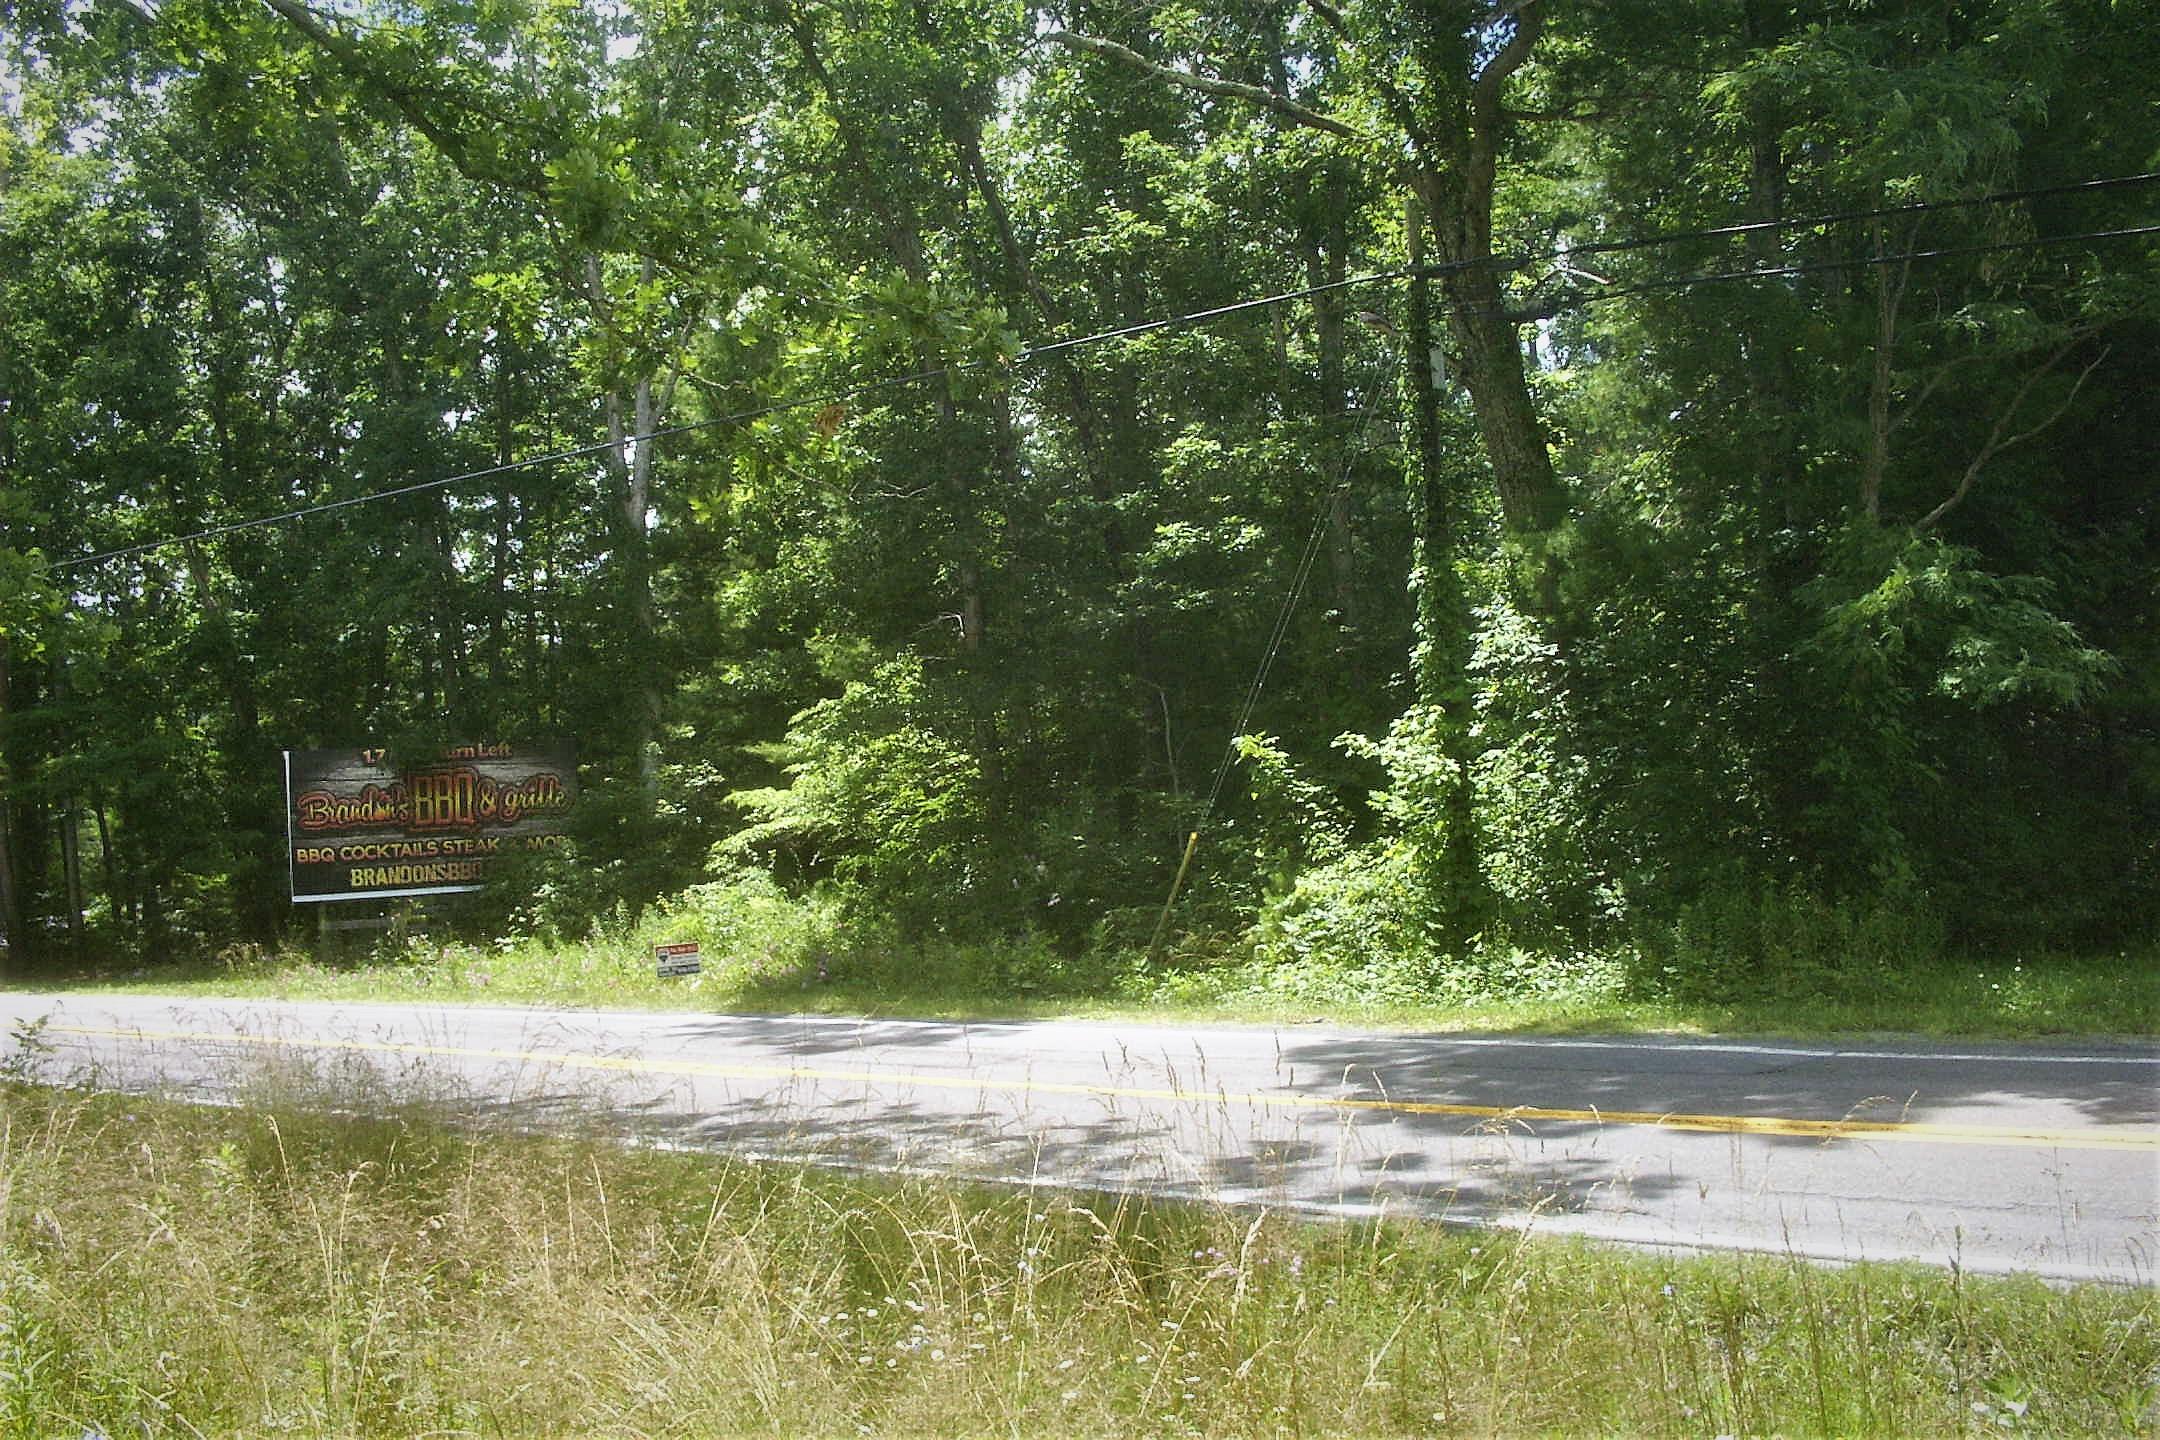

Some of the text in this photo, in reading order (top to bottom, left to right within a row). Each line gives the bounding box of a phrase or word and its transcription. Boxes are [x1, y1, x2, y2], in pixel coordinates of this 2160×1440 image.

[415, 773, 476, 825] BBQ
[479, 779, 497, 817] &
[296, 847, 336, 863] BBQ
[339, 840, 440, 861] COCKTAILS
[442, 837, 500, 855] STEAK
